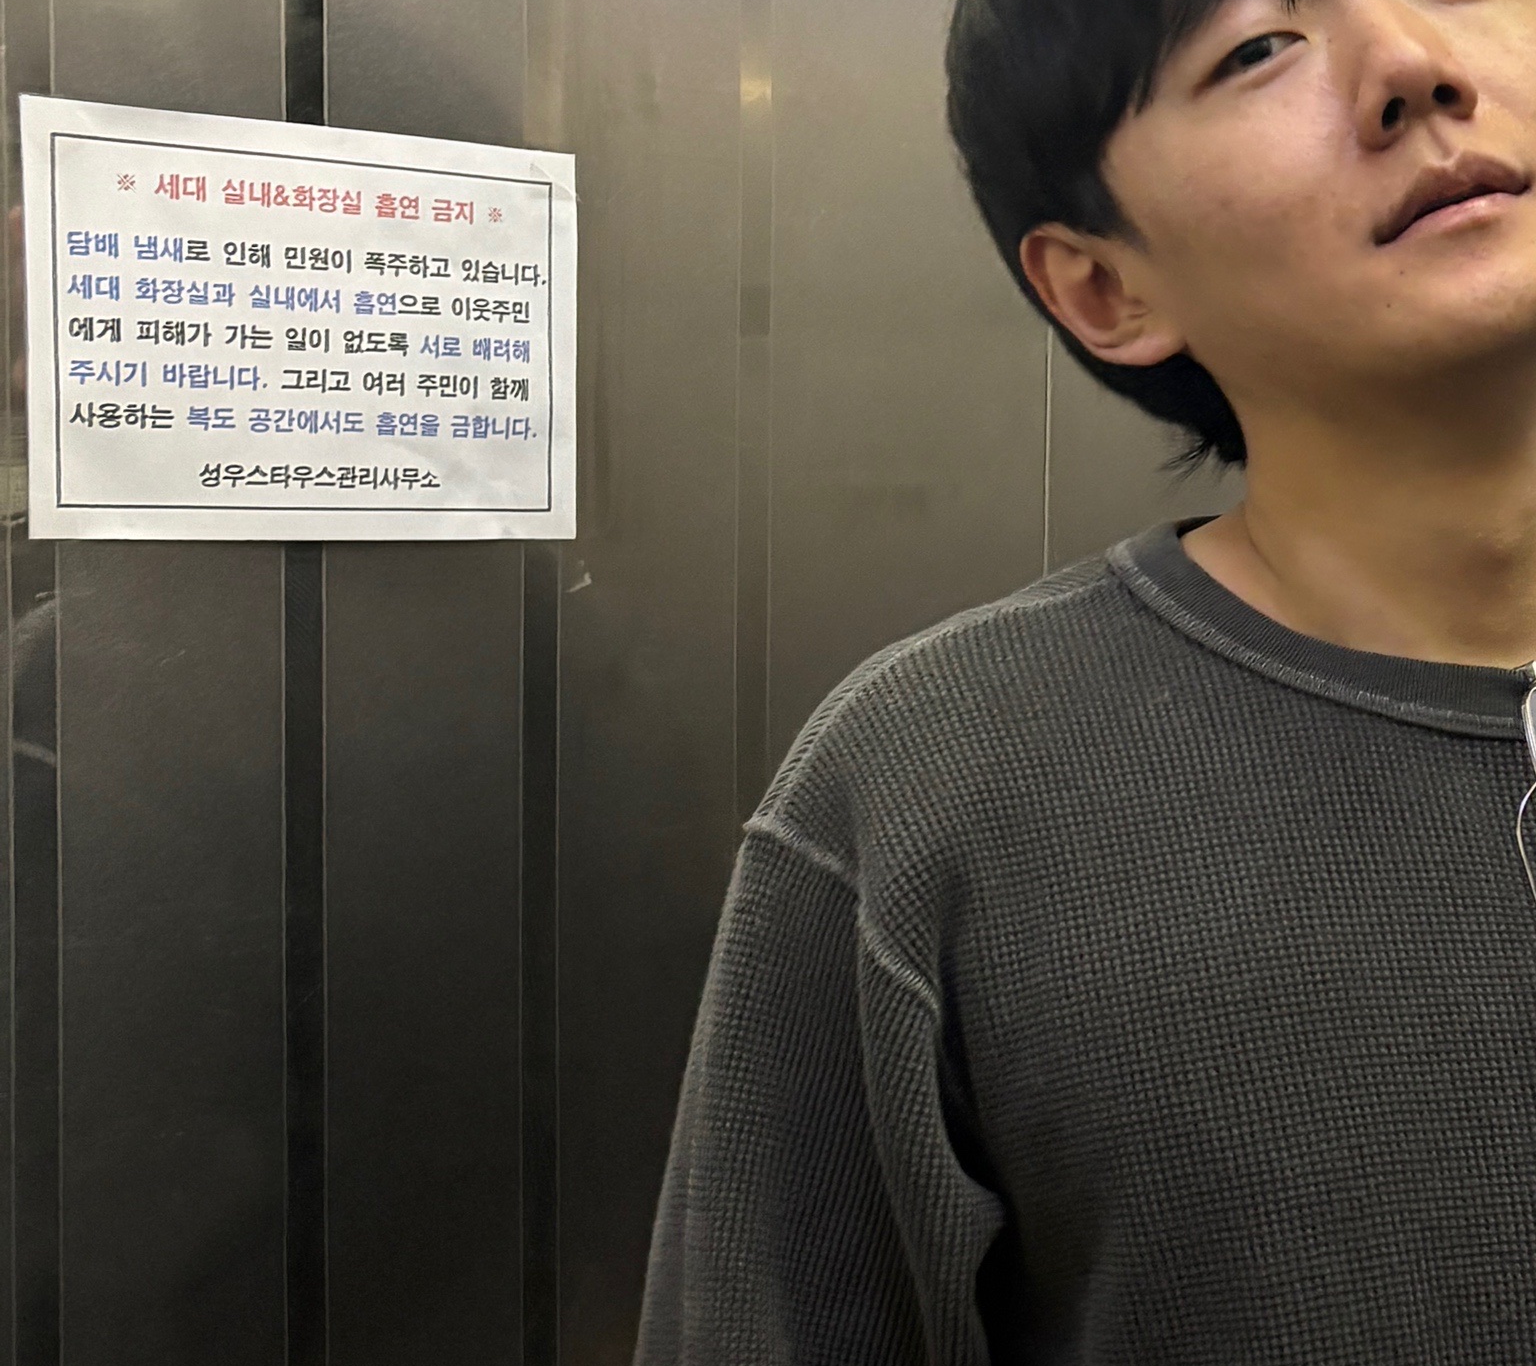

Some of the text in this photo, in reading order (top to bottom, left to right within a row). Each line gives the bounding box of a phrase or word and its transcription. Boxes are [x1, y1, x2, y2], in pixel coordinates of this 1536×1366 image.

[154, 173, 207, 202] 세대
[222, 179, 362, 215] 실내&화장실
[375, 193, 420, 220] 흡연
[431, 198, 475, 225] 금지
[66, 230, 547, 287] 담배 냄새로 인해 민원이 폭주하고 있습니다.
[67, 274, 530, 324] 세대 화장실과 실내에서 흡연으로 이웃주민
[68, 317, 530, 363] 에게 피해가 가는 일이 없도록 서로 배려해
[69, 359, 529, 402] 주시기 바랍니다. 그리고 여러 주민이 함께
[69, 401, 537, 441] 사용하는 복도 공간에서도 흡연을 금합니다.
[199, 463, 441, 491] 성우스타우스관리사무소
